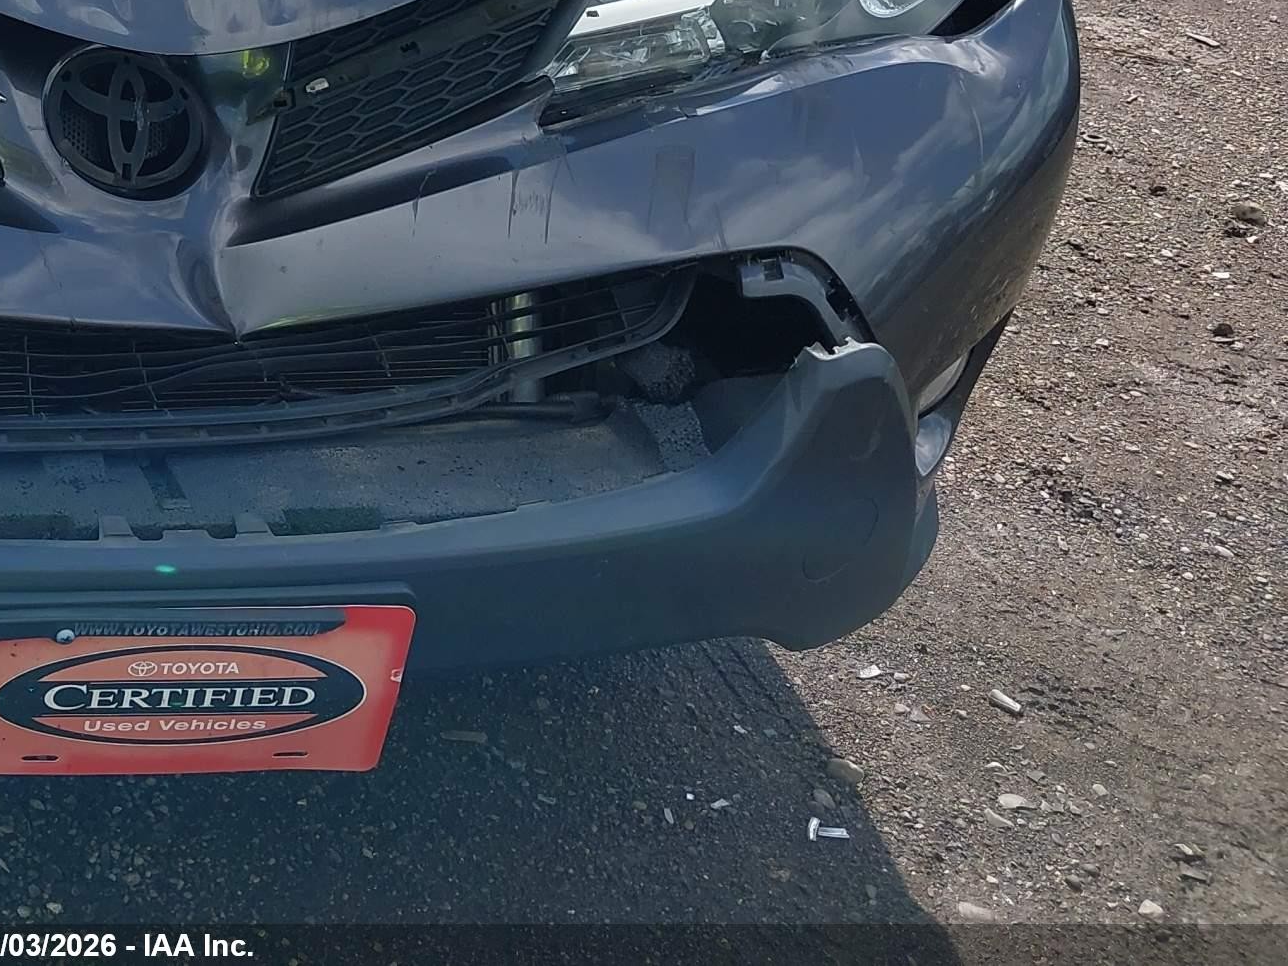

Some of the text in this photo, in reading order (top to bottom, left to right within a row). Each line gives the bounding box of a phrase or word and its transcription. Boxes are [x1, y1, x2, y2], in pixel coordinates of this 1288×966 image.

[161, 662, 240, 675] TOYOTA
[43, 684, 316, 711] CERTIFIED
[84, 718, 267, 732] Used Vehicles
